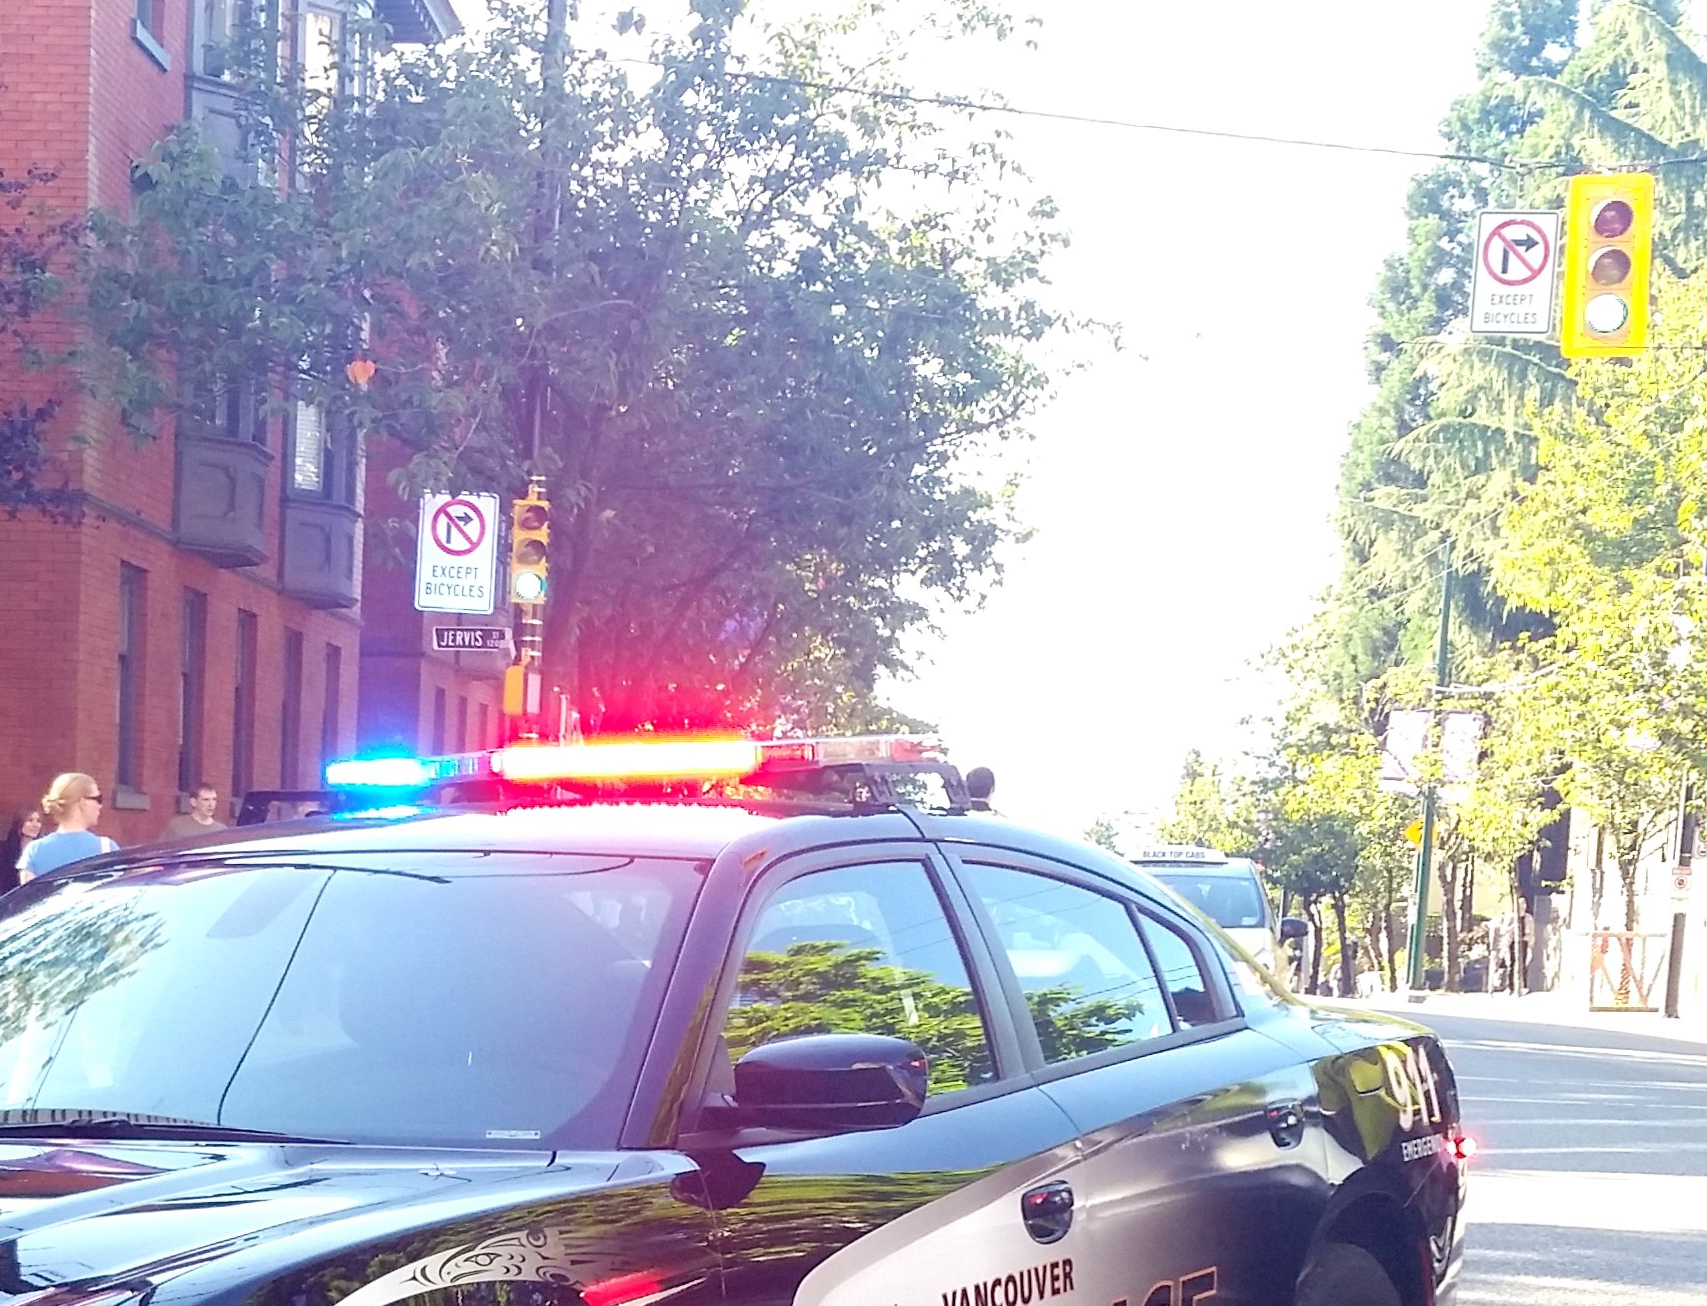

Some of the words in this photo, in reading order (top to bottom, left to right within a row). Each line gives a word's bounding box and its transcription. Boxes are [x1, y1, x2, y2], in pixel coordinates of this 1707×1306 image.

[1490, 294, 1534, 306] EXCEPT
[1483, 312, 1538, 324] BICYCLES
[431, 565, 480, 580] EXCEPT
[424, 582, 485, 598] BICYCLES
[439, 630, 484, 647] JERVIS
[1142, 850, 1167, 859] BLACK
[1169, 851, 1184, 859] TOP
[1384, 1044, 1442, 1132] 911
